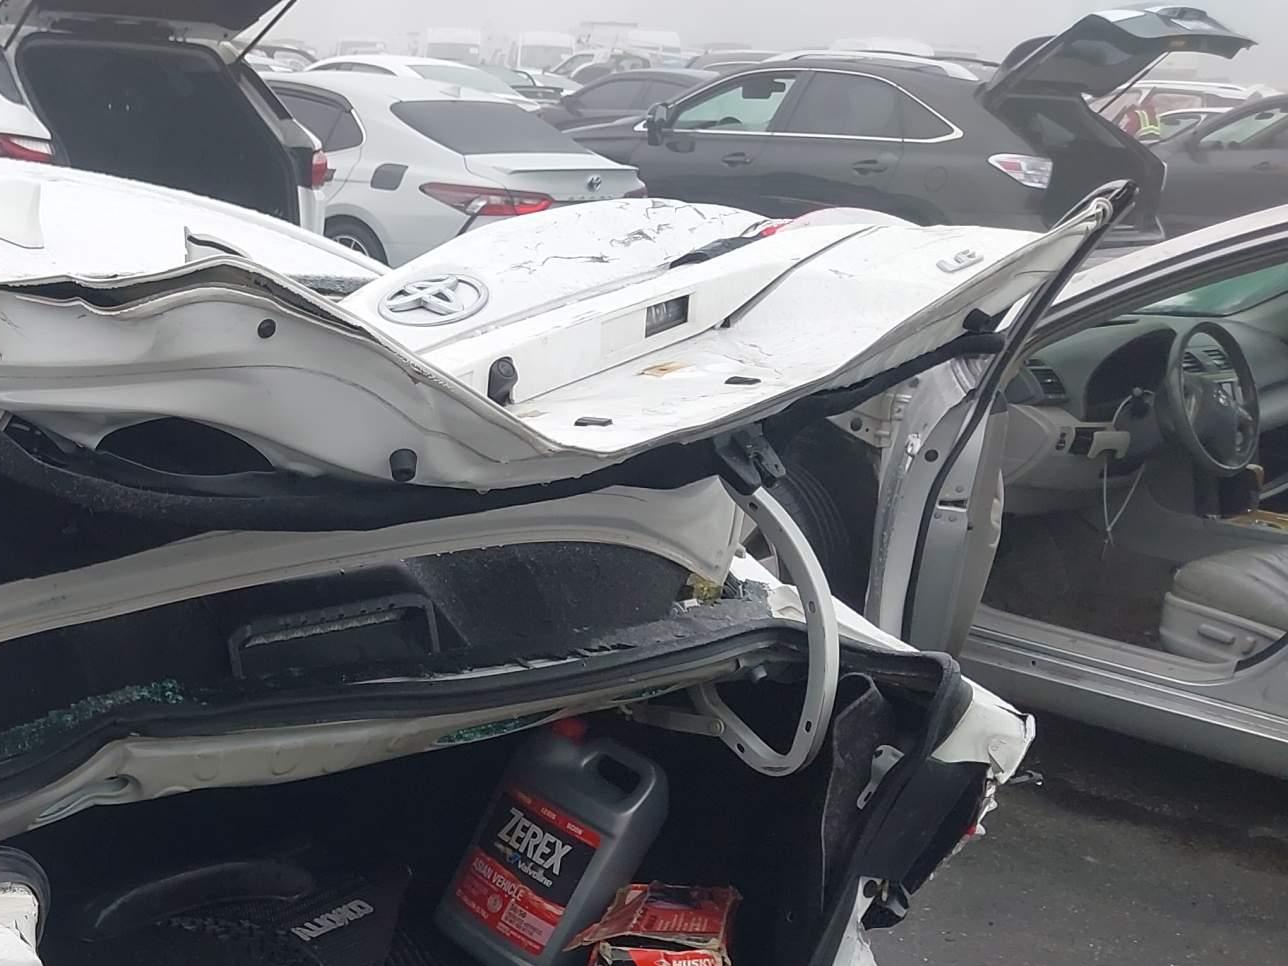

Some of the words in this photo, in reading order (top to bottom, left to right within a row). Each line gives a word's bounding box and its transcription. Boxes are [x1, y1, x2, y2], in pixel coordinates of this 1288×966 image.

[497, 807, 573, 876] ZEREX
[491, 870, 524, 901] VEHICLE
[517, 860, 553, 888] Valvoline
